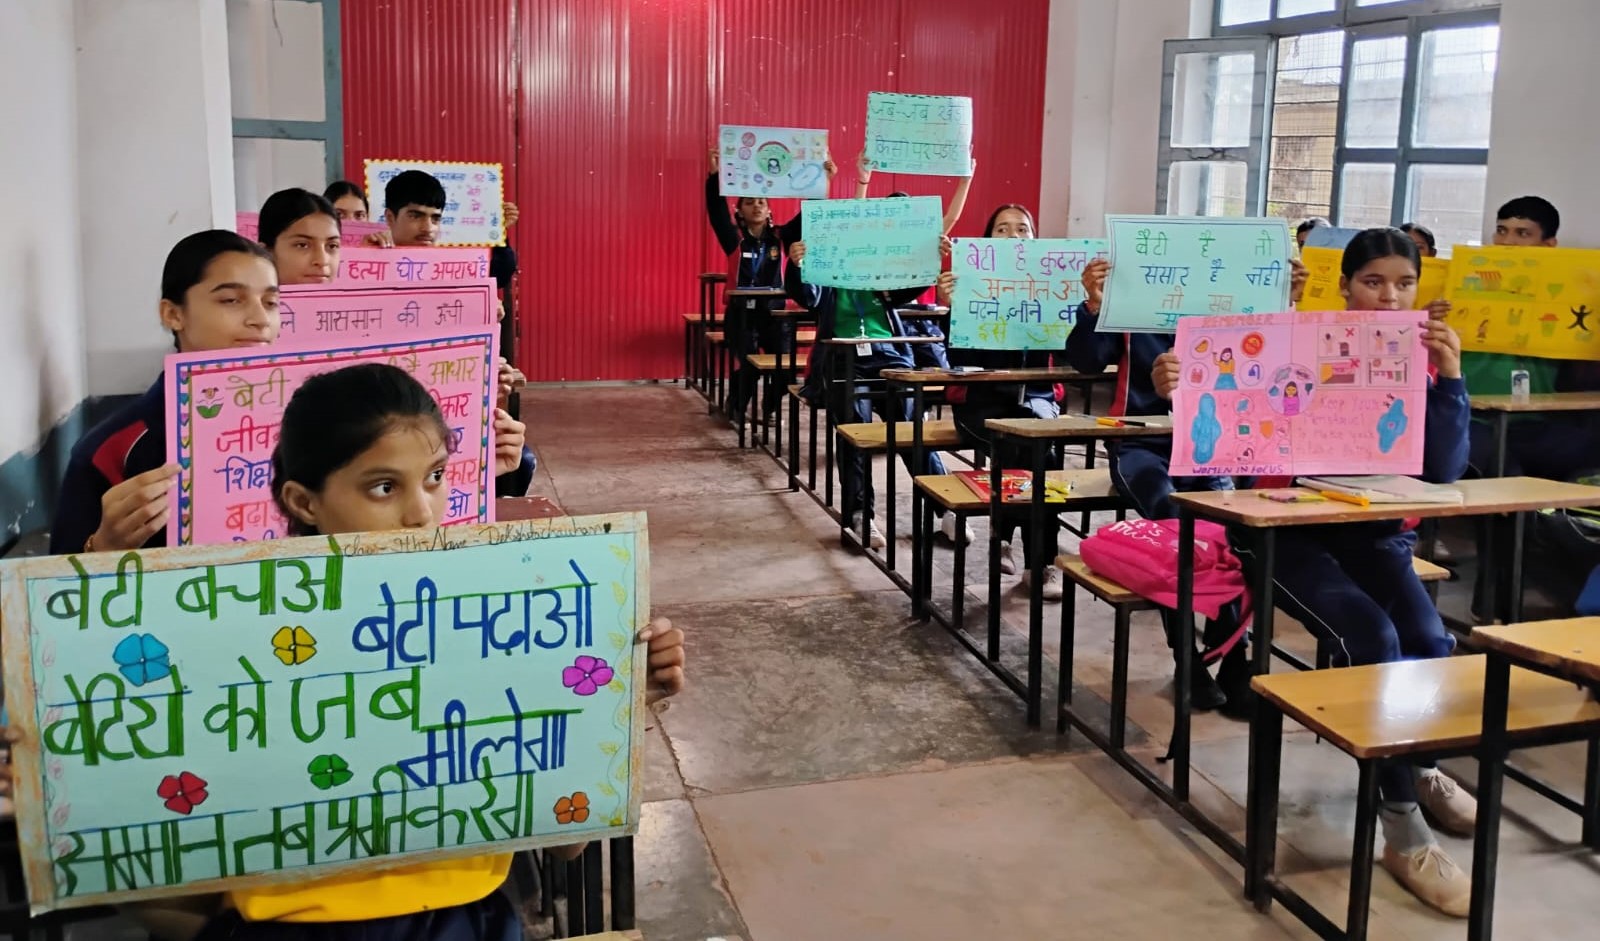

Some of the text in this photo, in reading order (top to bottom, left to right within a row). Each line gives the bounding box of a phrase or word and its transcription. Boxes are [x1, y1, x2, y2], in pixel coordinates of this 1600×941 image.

[348, 260, 390, 281] हत्या
[396, 257, 428, 281] घोर
[966, 243, 1087, 276] बेटी है कुदरत
[972, 273, 1050, 300] अनमोल
[278, 301, 296, 334] ले
[316, 308, 382, 332] आसमान
[397, 301, 421, 328] की
[226, 368, 291, 411] बेटी
[216, 415, 281, 453] जीव
[214, 456, 273, 494] शिक्ष
[446, 458, 480, 487] कार
[1235, 465, 1249, 474] IN
[46, 551, 143, 630] बेटी
[351, 576, 438, 671] बेटी
[203, 655, 272, 752] को
